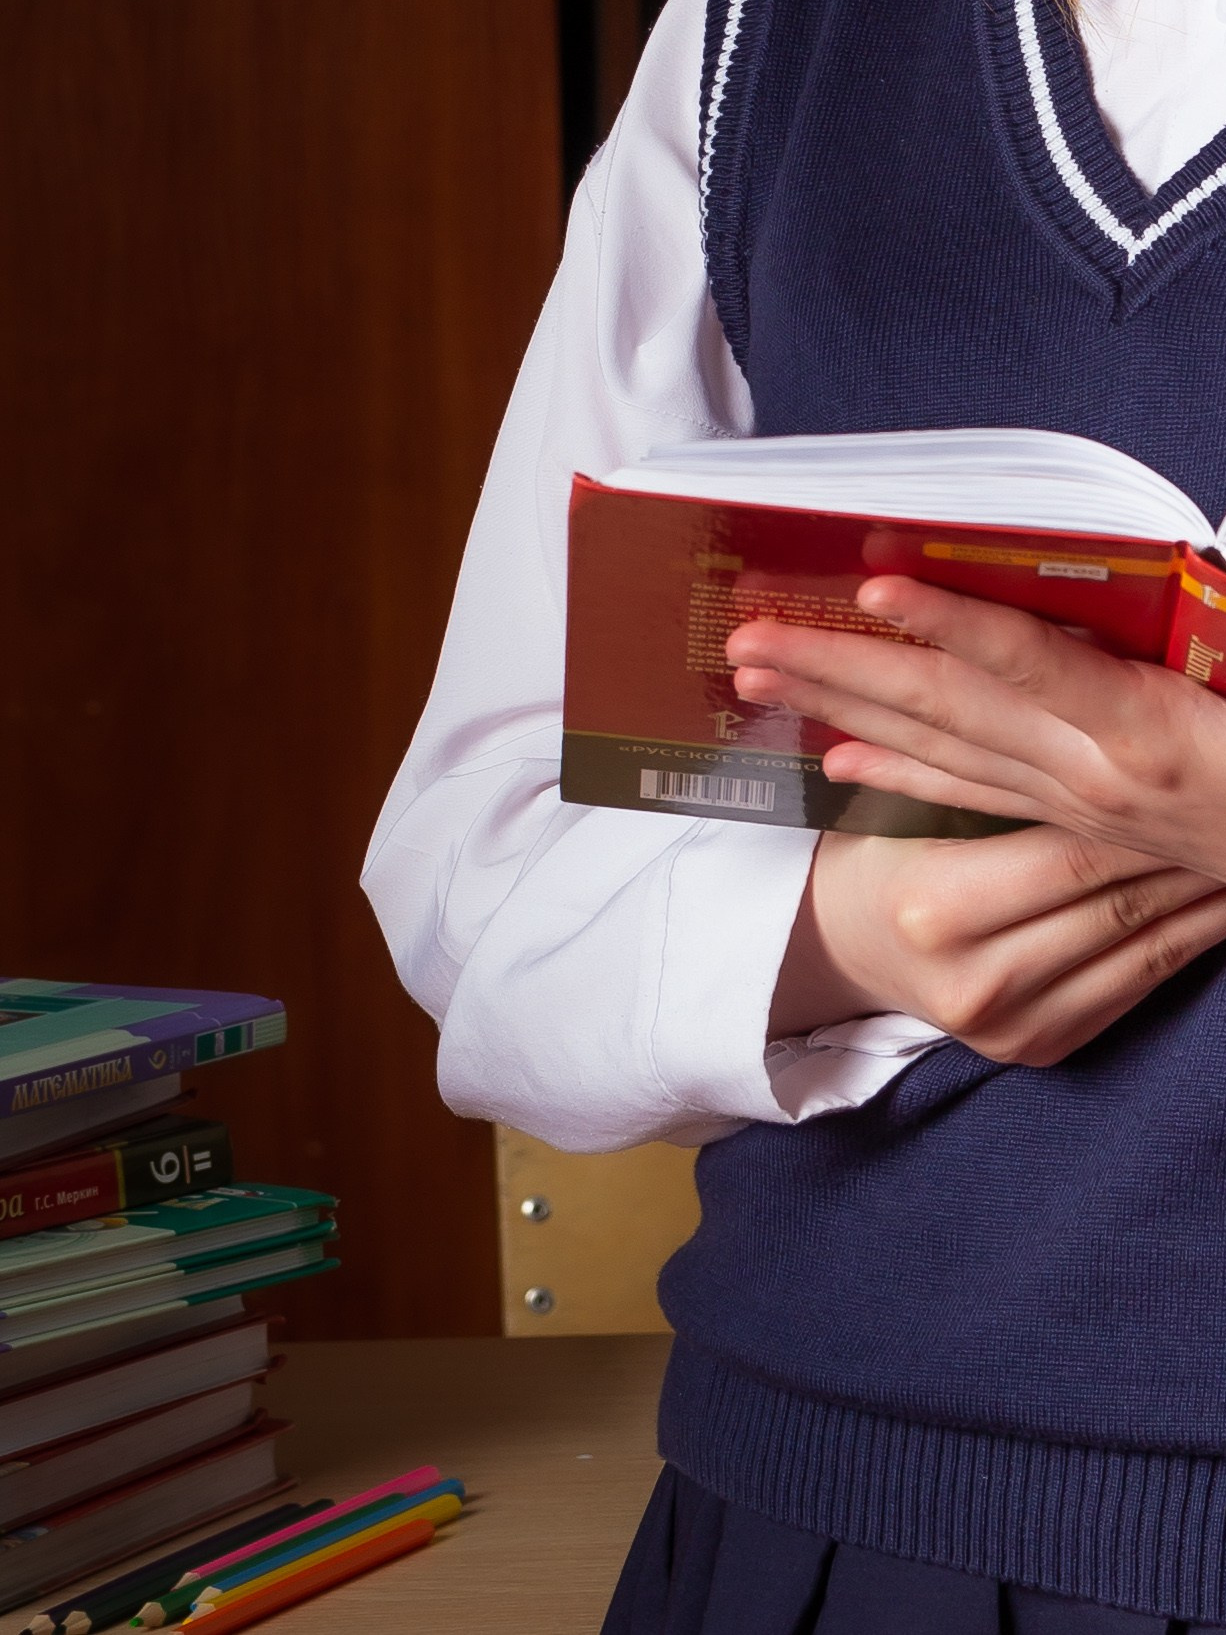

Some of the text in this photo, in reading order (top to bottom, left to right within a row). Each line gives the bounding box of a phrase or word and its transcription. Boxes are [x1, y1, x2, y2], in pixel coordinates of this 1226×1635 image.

[12, 1056, 133, 1111] МАТЕМАТИКА
[150, 1151, 180, 1184] 6
[35, 1195, 55, 1211] Г.С.
[57, 1185, 99, 1206] Меркин
